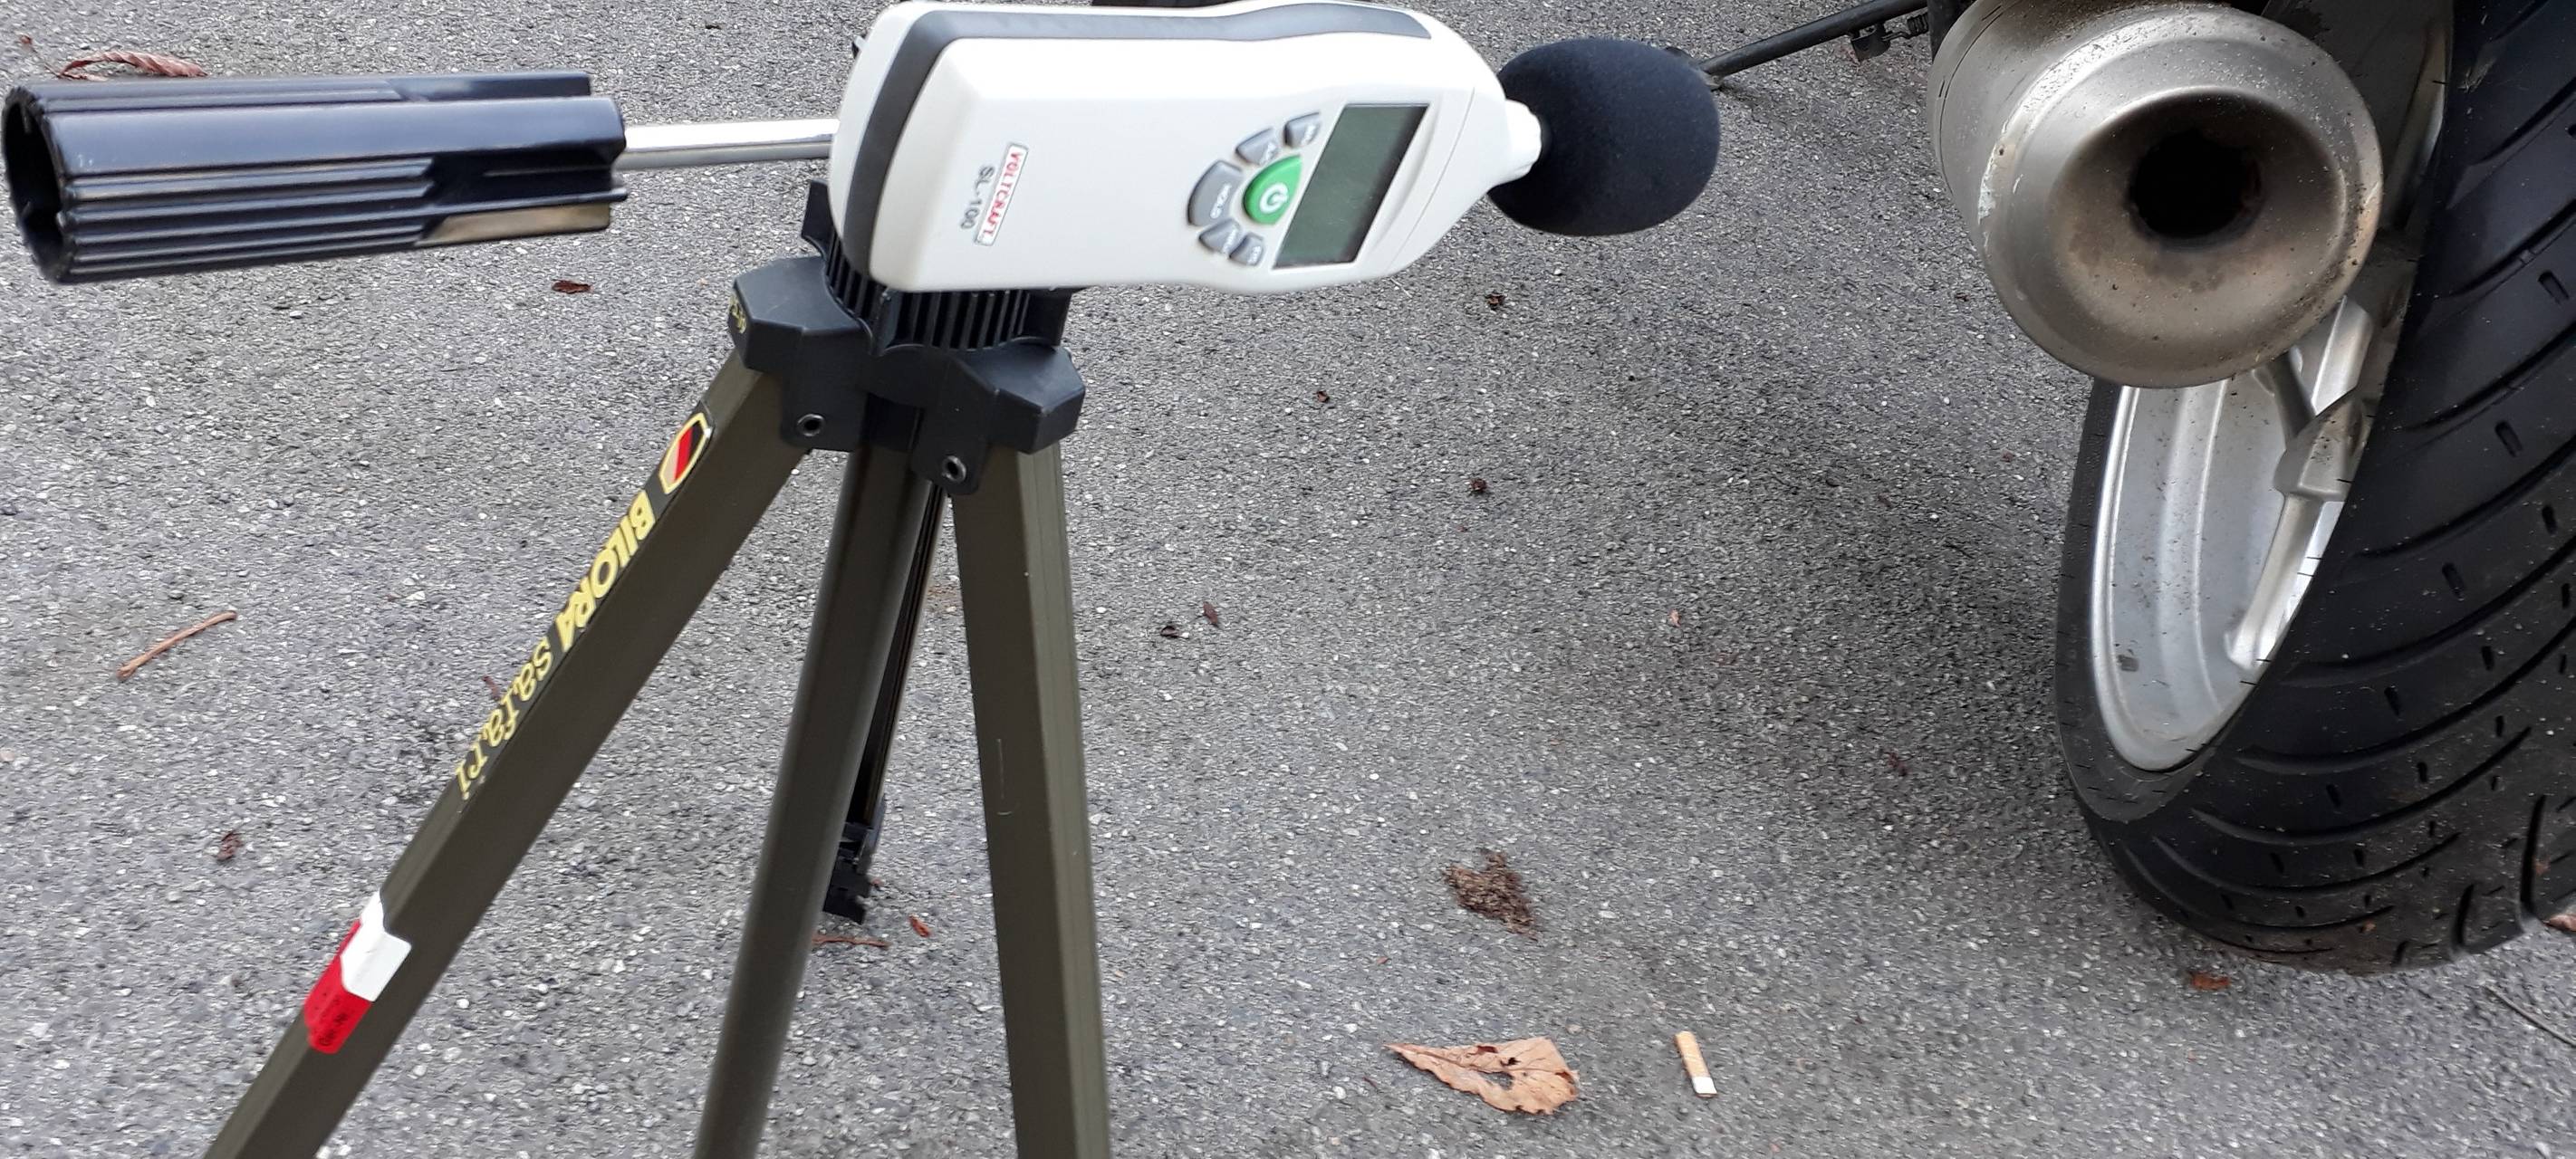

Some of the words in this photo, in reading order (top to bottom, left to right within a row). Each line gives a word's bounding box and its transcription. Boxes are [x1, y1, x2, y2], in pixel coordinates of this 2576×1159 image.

[959, 165, 995, 230] SL-100
[555, 490, 656, 653] BILORA
[455, 636, 553, 800] safari
